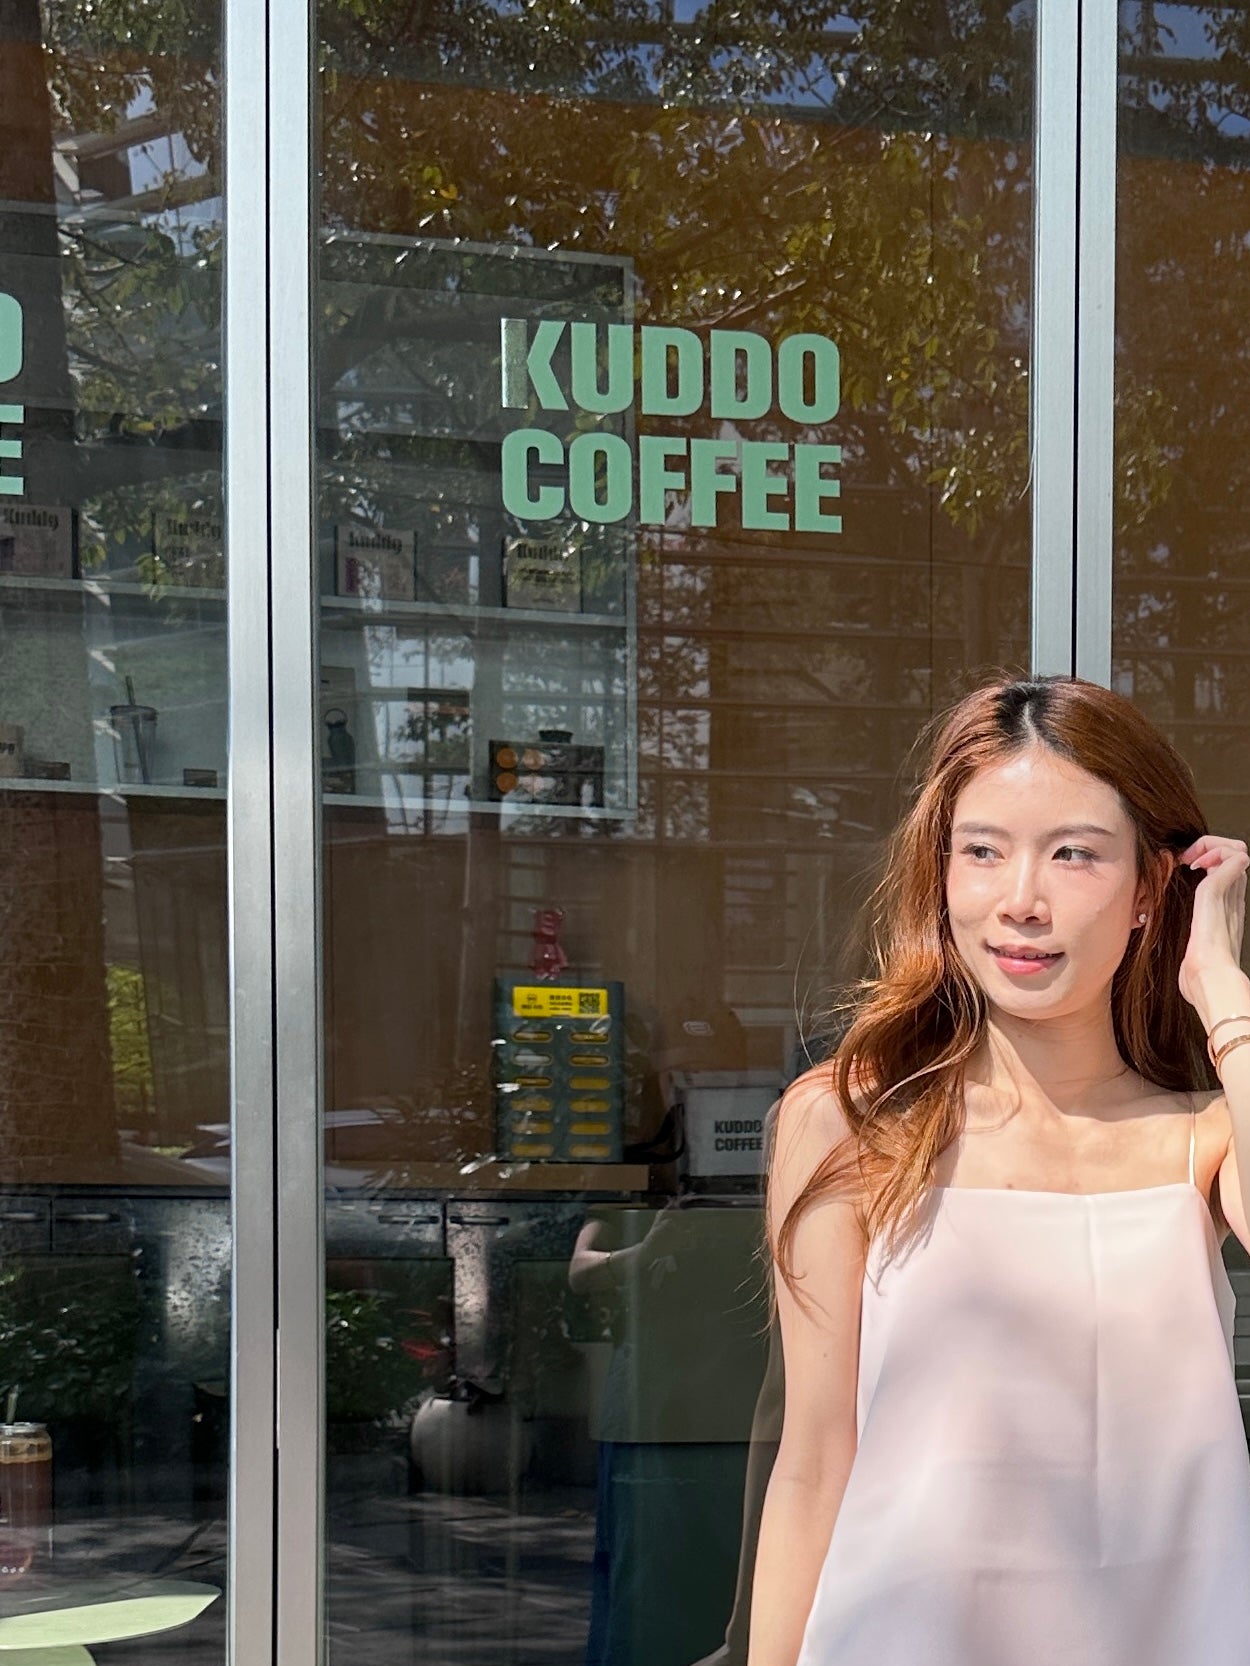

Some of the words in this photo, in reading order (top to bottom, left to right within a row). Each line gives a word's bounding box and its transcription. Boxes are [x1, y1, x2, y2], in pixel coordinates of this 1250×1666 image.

[501, 318, 841, 424] KUDDO
[501, 428, 842, 533] COFFEE
[715, 1138, 763, 1152] COFFEE
